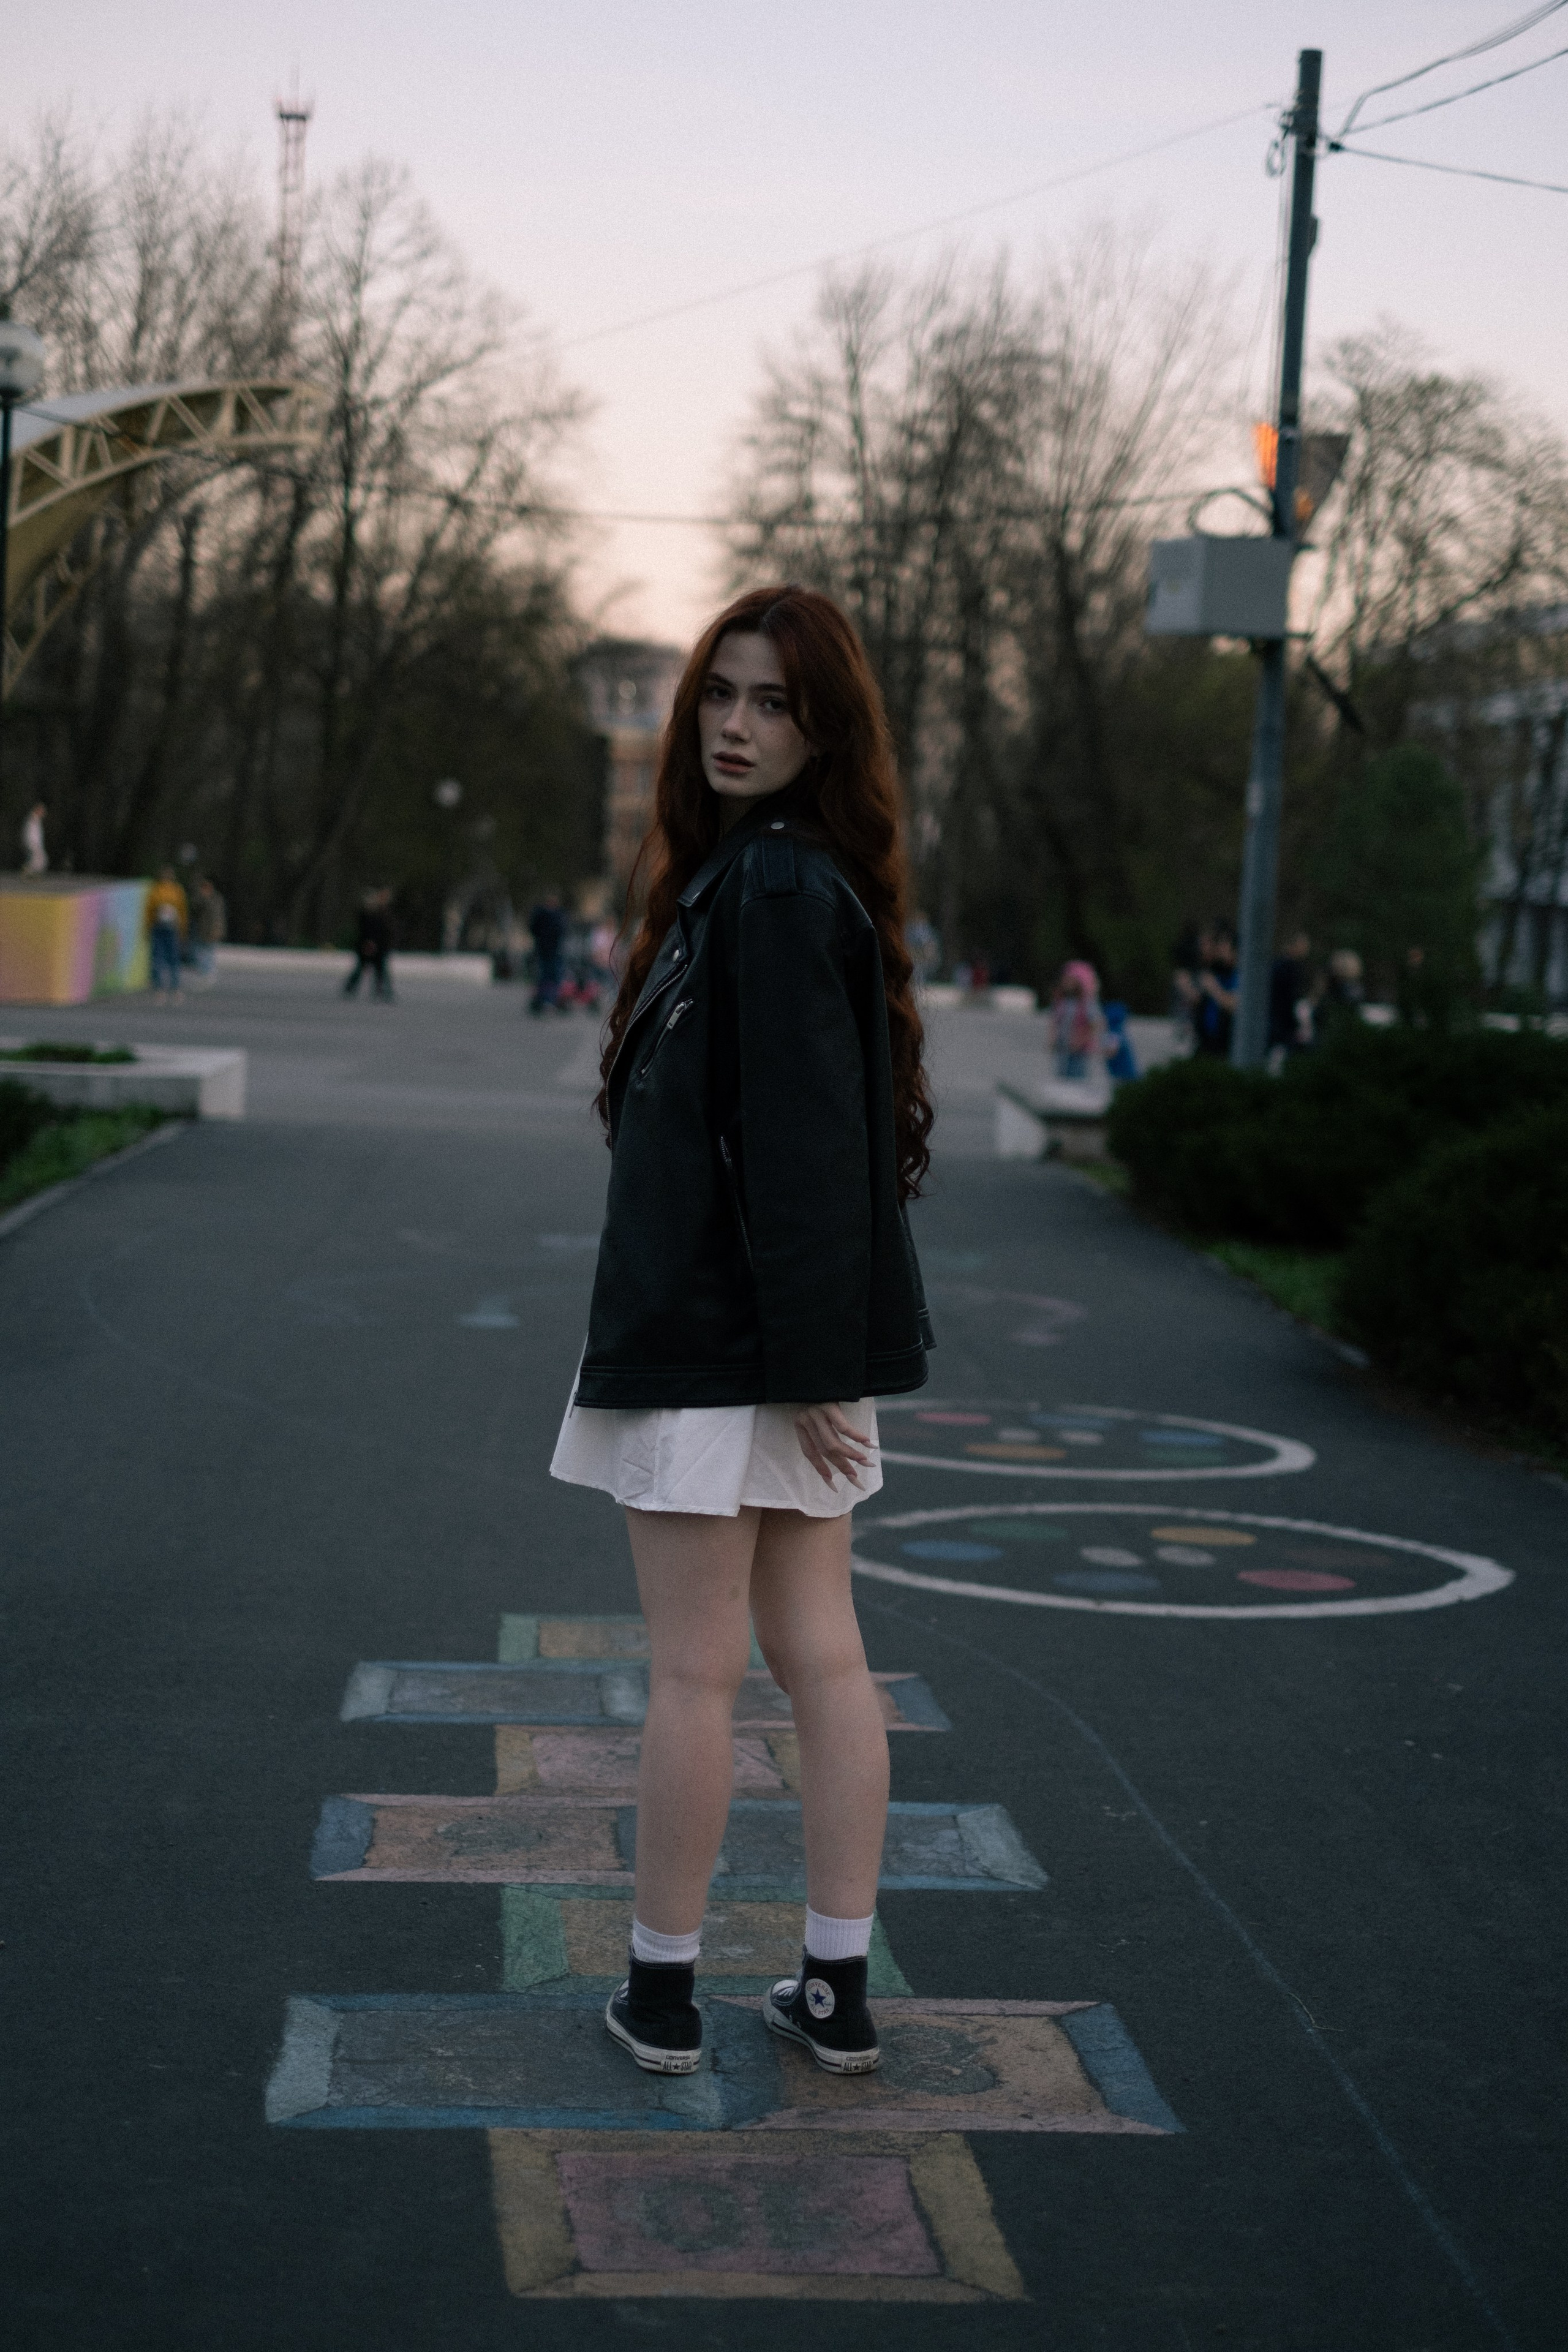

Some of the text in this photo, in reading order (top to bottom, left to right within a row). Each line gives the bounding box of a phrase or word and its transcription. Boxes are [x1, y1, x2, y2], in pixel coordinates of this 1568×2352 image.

[807, 1981, 830, 1997] CONVERSE
[662, 2061, 692, 2071] ALL STAR
[843, 2060, 872, 2071] ALL STAR
